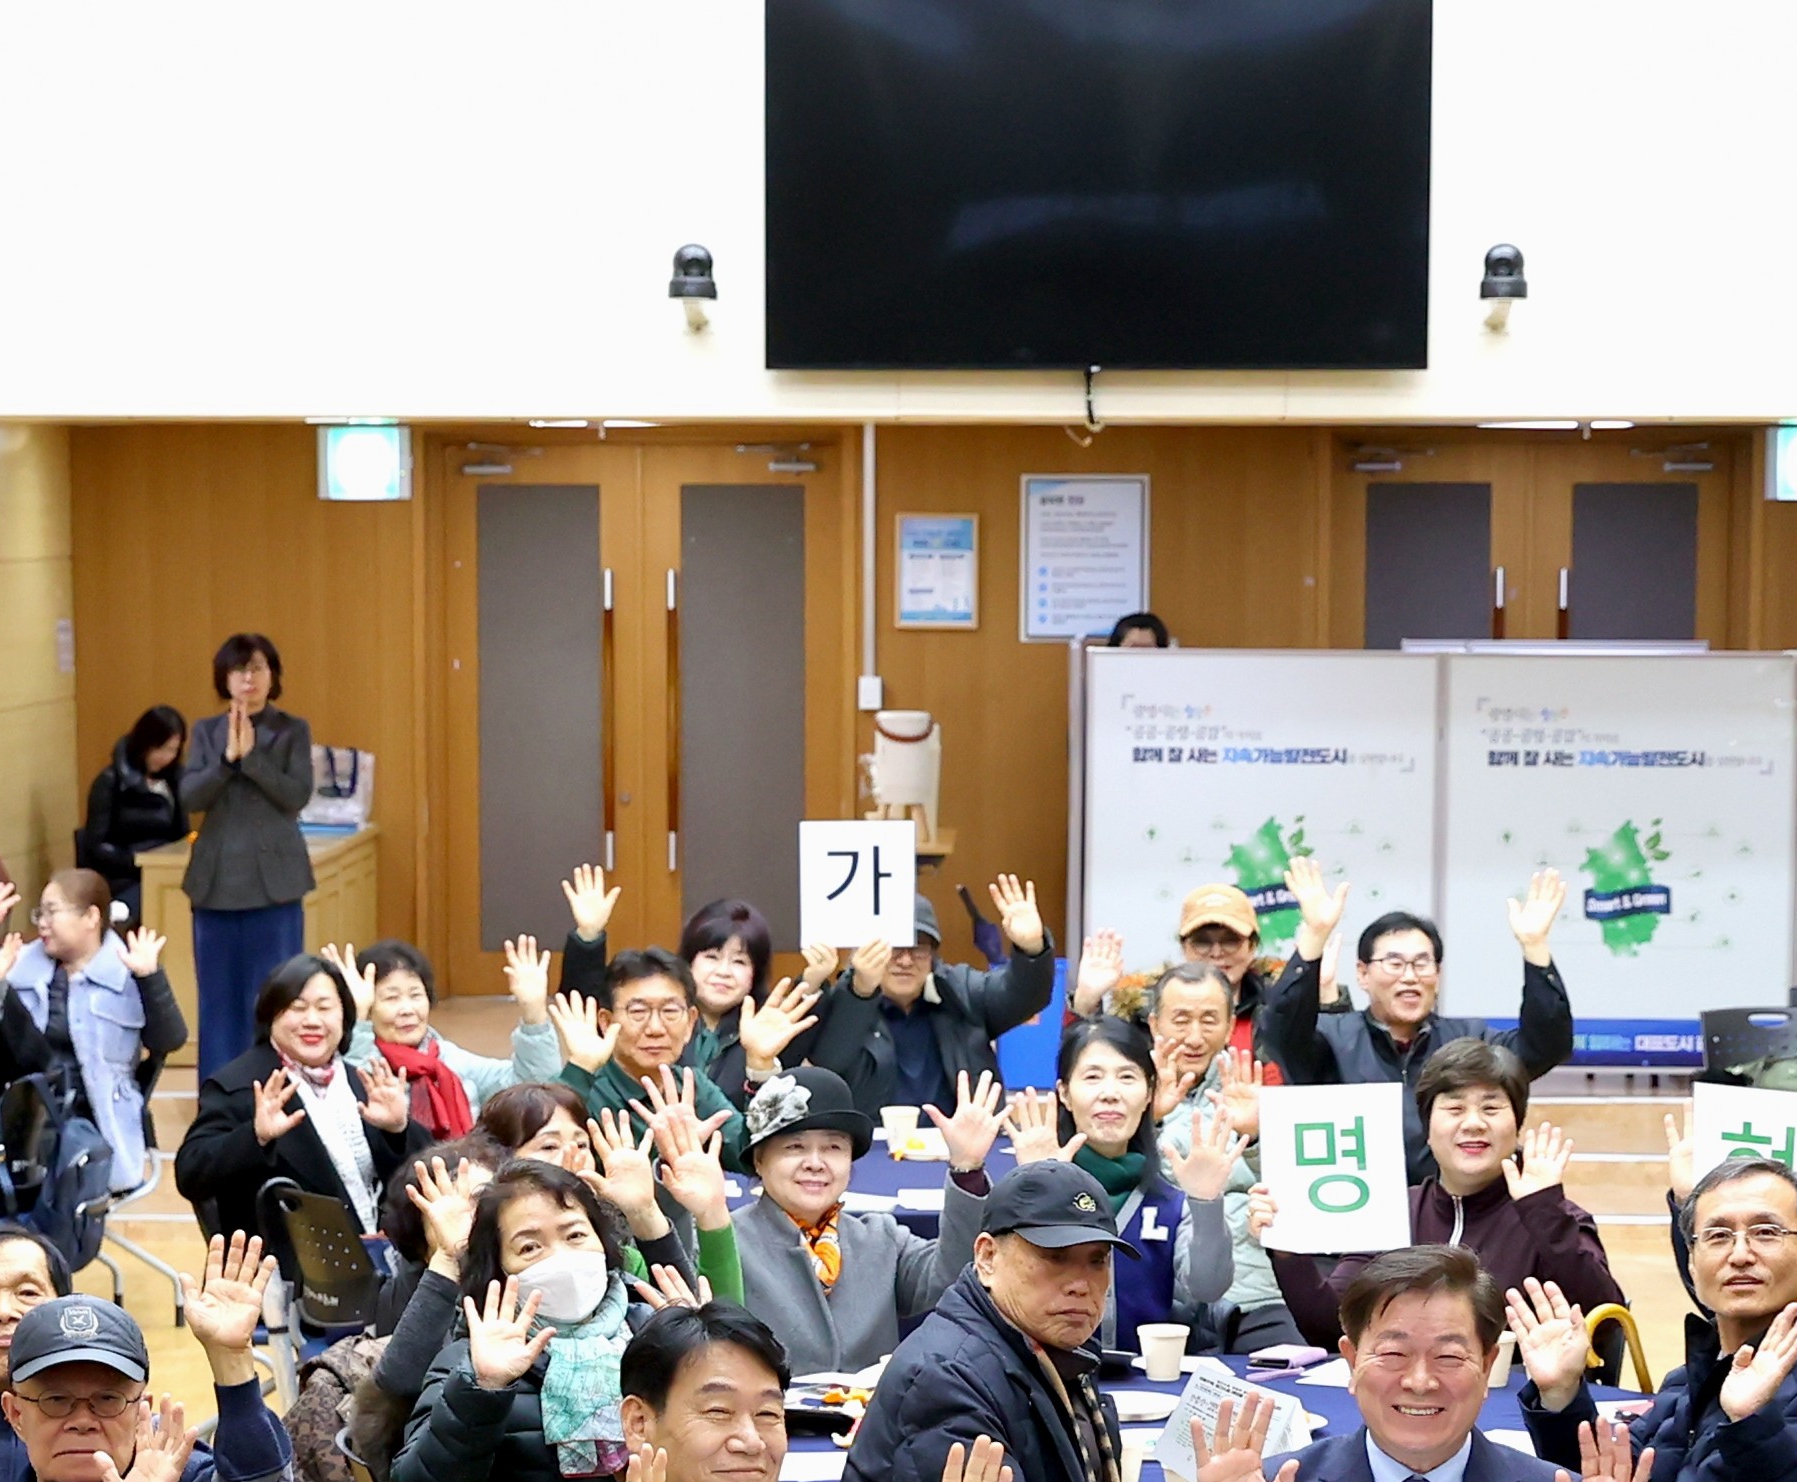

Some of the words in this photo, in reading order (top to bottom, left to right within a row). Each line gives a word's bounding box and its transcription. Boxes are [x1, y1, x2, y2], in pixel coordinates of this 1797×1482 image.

[826, 845, 892, 916] 가
[1295, 1116, 1370, 1213] 명
[1140, 1206, 1169, 1241] L
